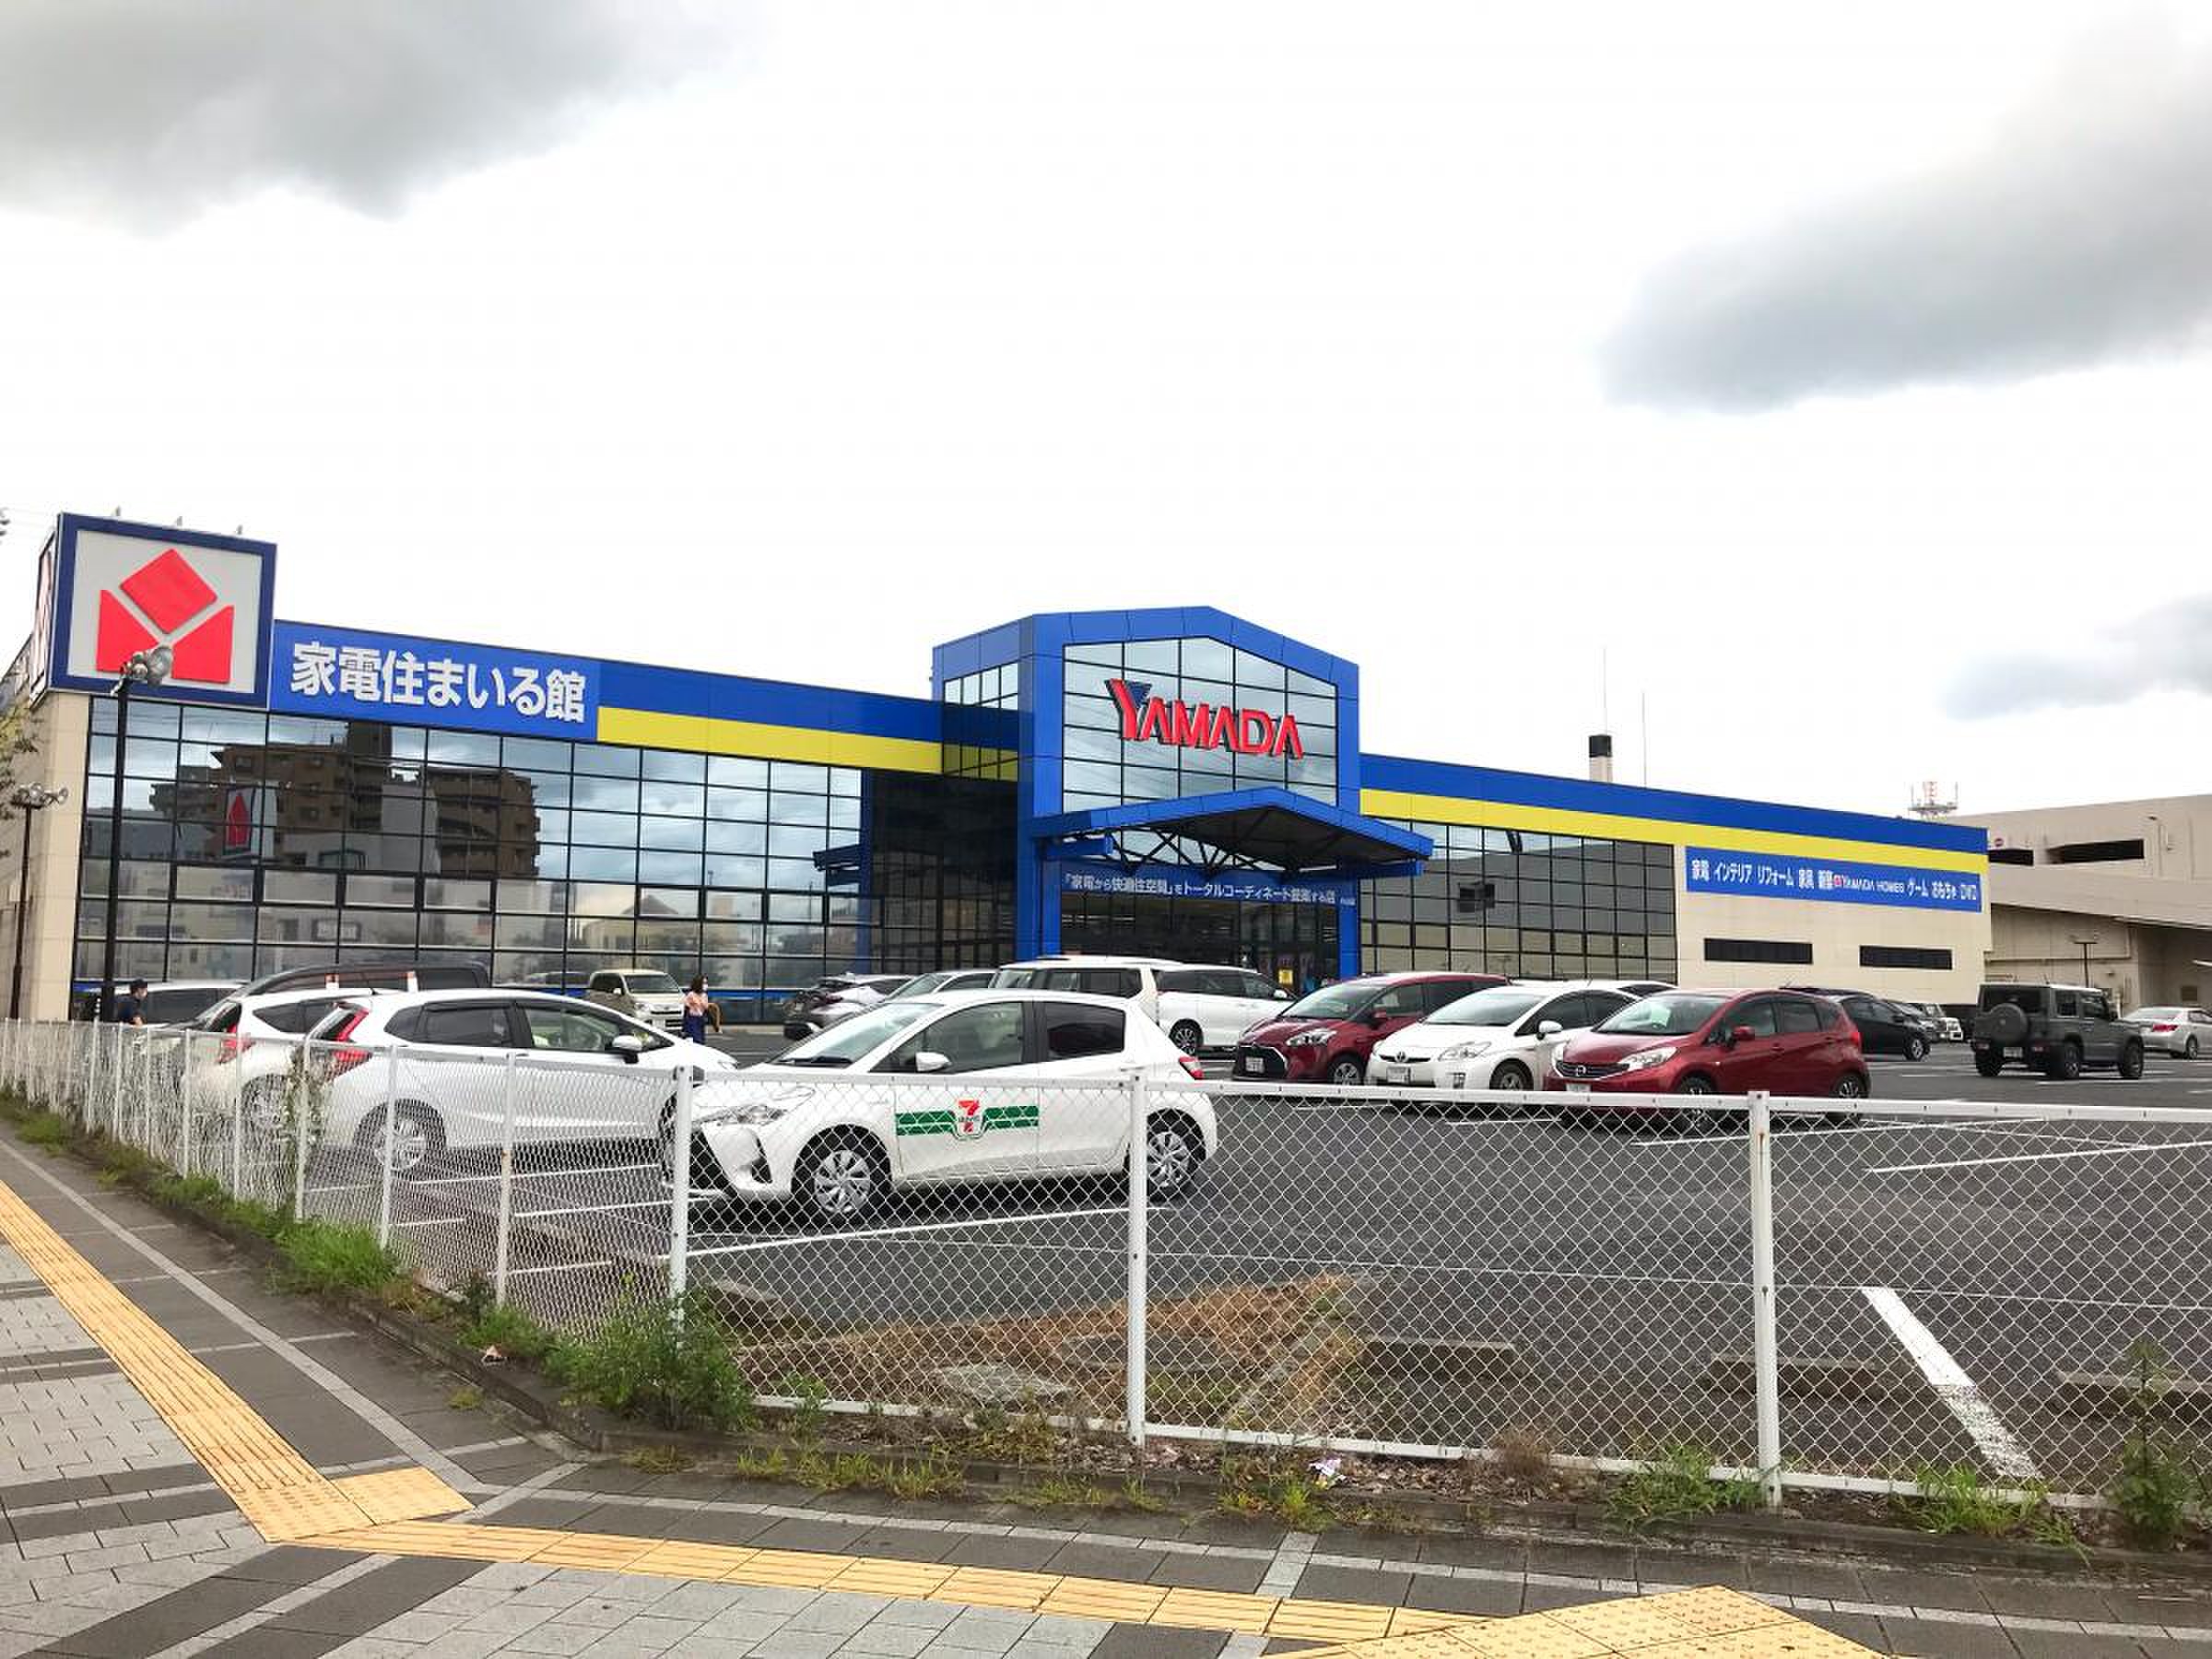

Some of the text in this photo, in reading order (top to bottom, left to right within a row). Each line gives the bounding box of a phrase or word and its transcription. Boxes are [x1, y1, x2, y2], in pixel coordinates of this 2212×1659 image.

[290, 641, 586, 724] 家電住まいる館
[1104, 677, 1304, 760] YAMADA
[1713, 862, 1753, 884] インテリア
[1757, 864, 1794, 886] リフォーム
[1907, 877, 1929, 897] ゲーム
